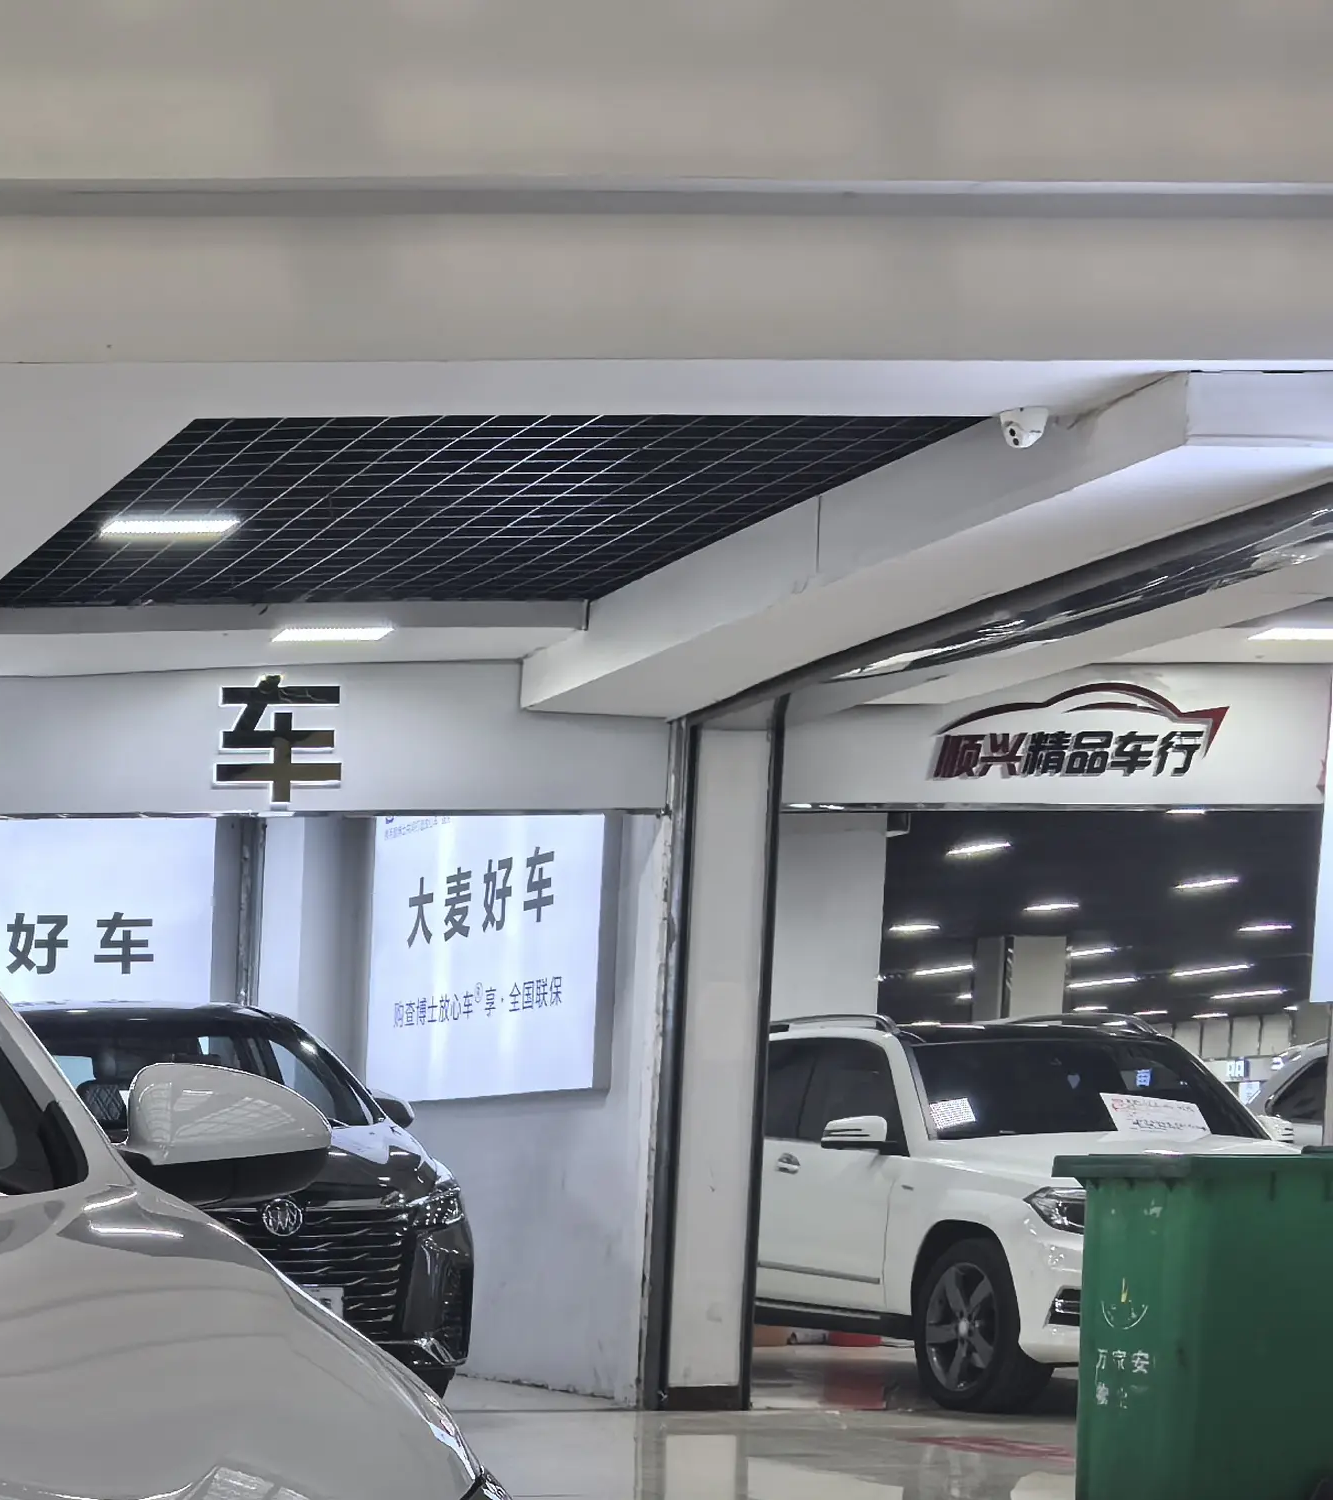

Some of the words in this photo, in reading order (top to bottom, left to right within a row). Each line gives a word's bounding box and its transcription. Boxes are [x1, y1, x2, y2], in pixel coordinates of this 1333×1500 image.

[930, 730, 1205, 780] 顺兴精品车行
[406, 846, 555, 949] 大麦好车
